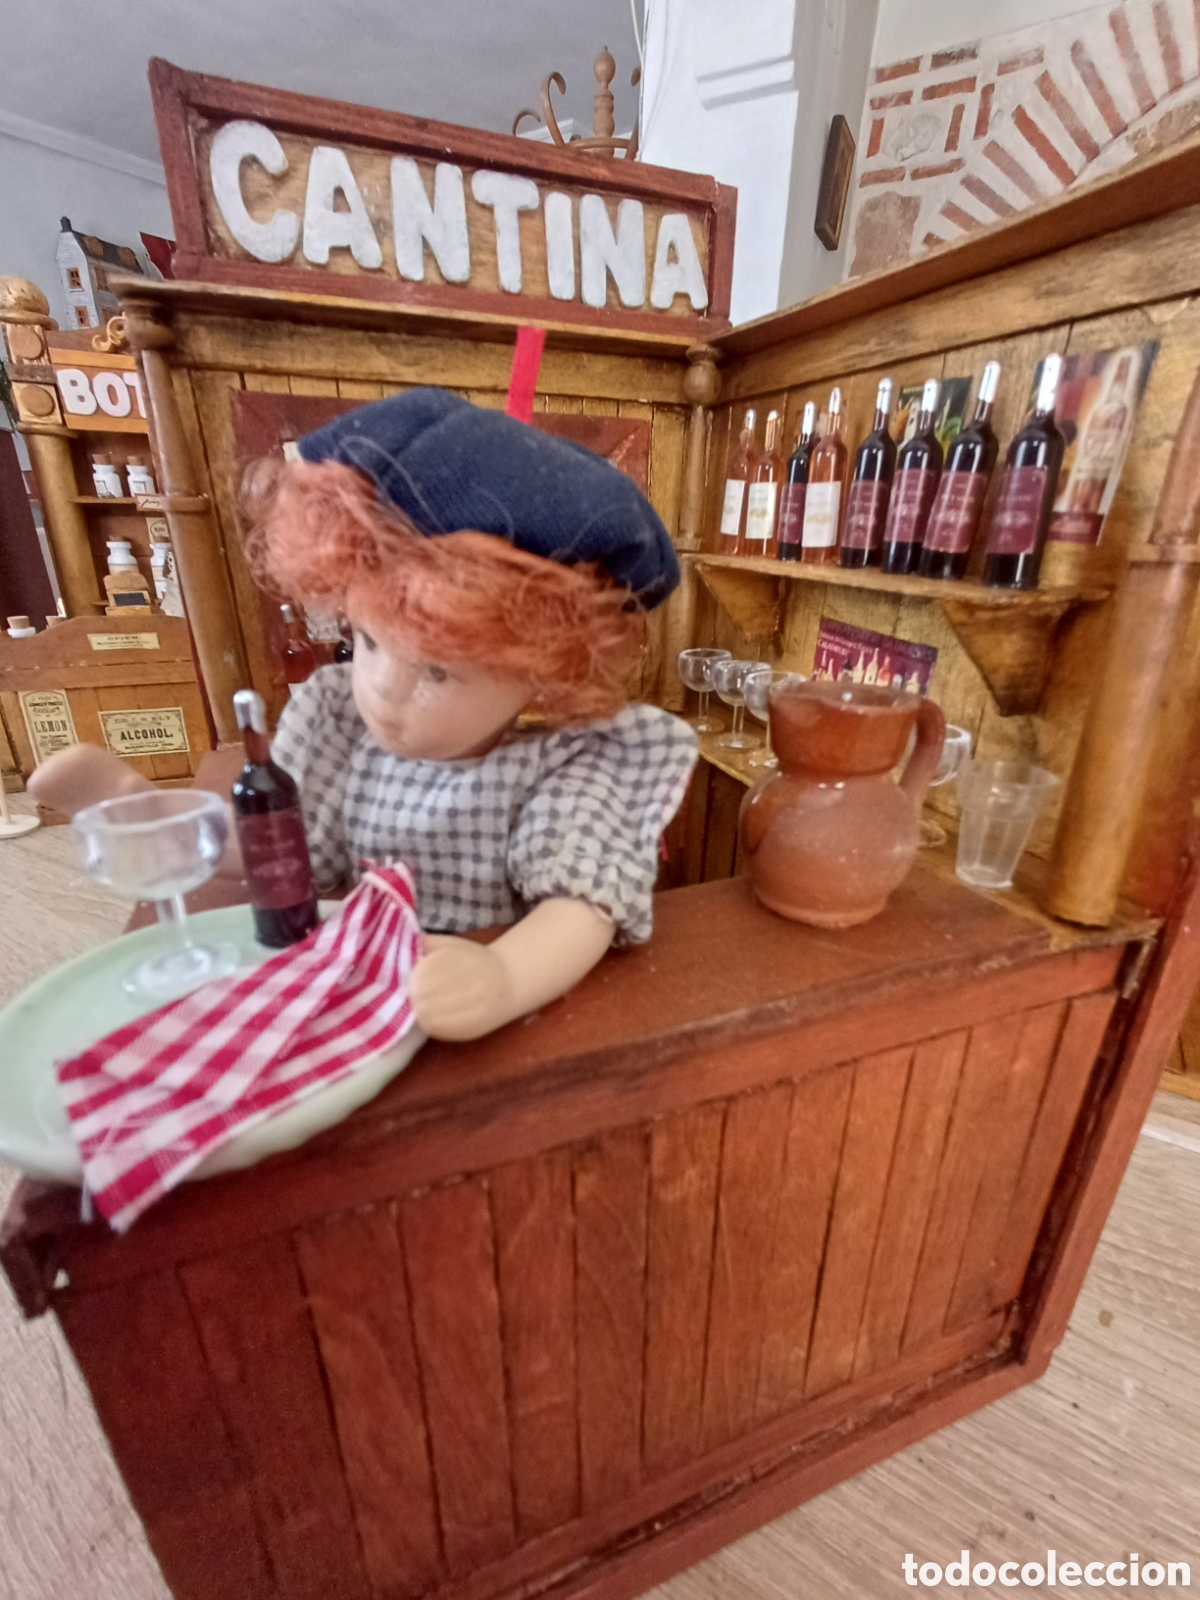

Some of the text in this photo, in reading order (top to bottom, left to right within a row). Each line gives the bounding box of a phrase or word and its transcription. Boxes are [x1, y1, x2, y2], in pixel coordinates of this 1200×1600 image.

[210, 120, 708, 309] CANTINA
[34, 720, 68, 733] LEMON
[120, 727, 174, 741] ALCOHOL.
